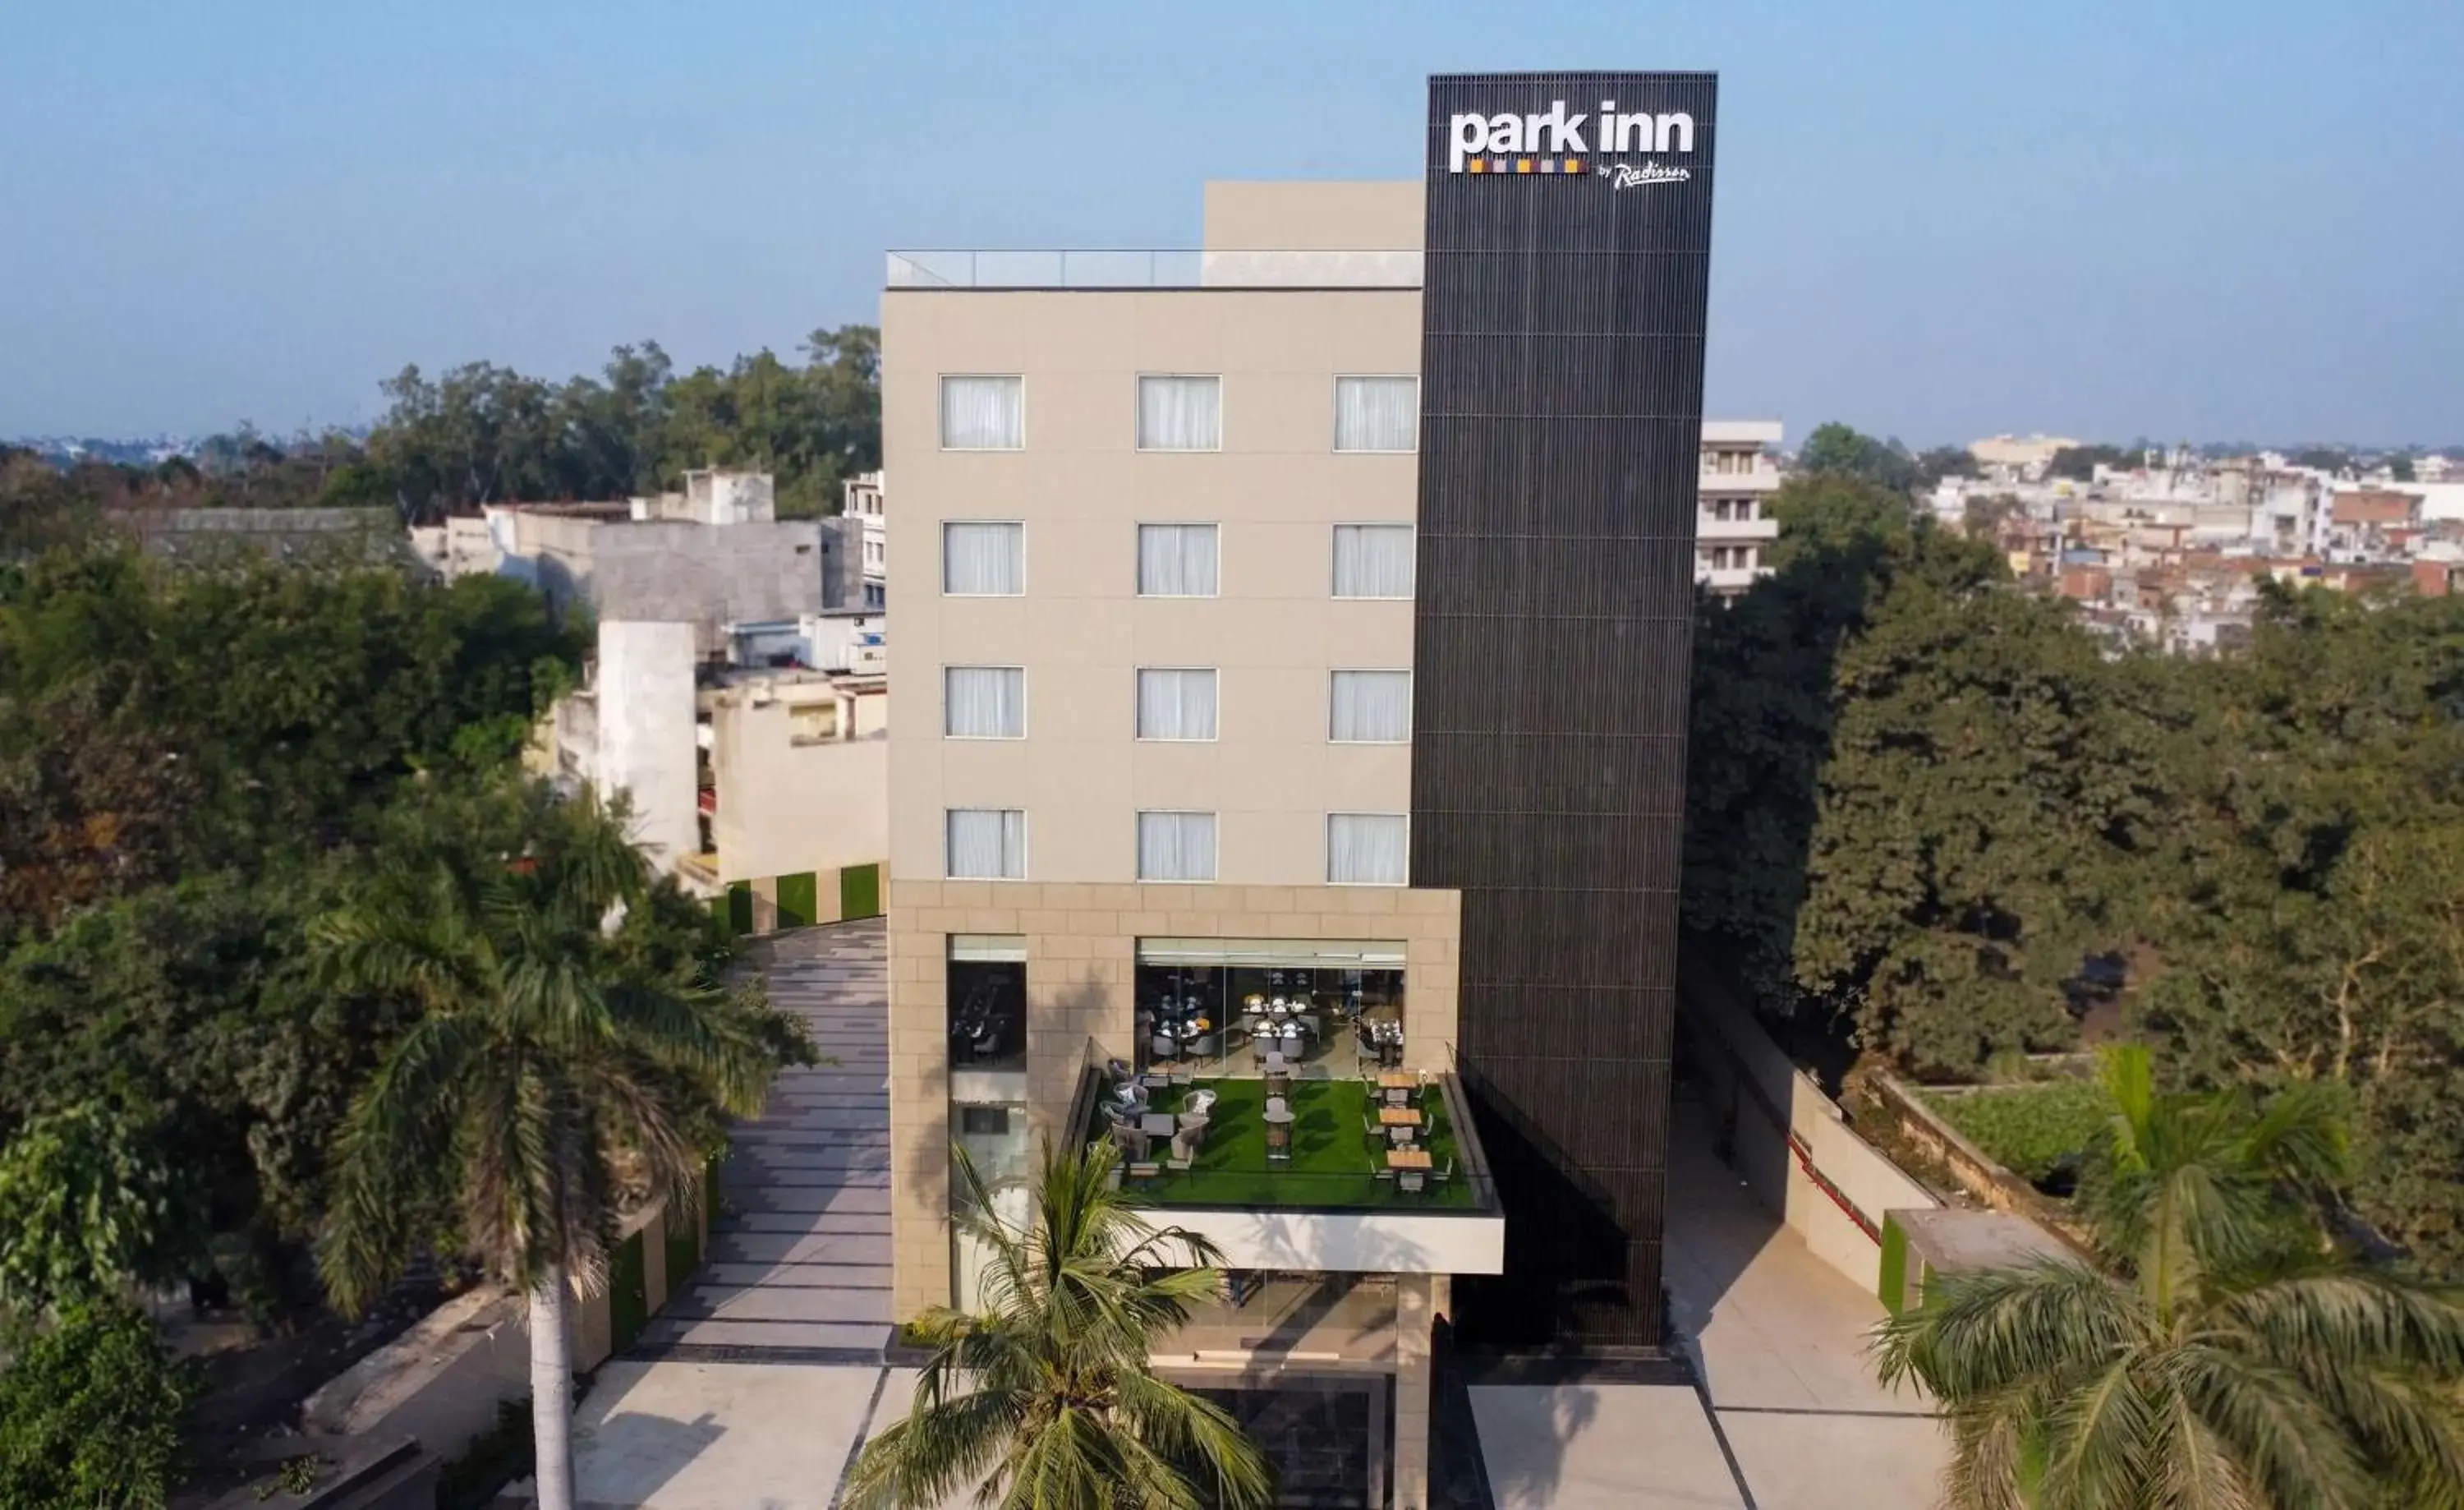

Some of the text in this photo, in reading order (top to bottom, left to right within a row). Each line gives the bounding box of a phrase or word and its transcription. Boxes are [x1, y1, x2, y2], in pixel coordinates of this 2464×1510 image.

[1450, 100, 1693, 173] park inn
[1598, 161, 1690, 190] by Radisson
